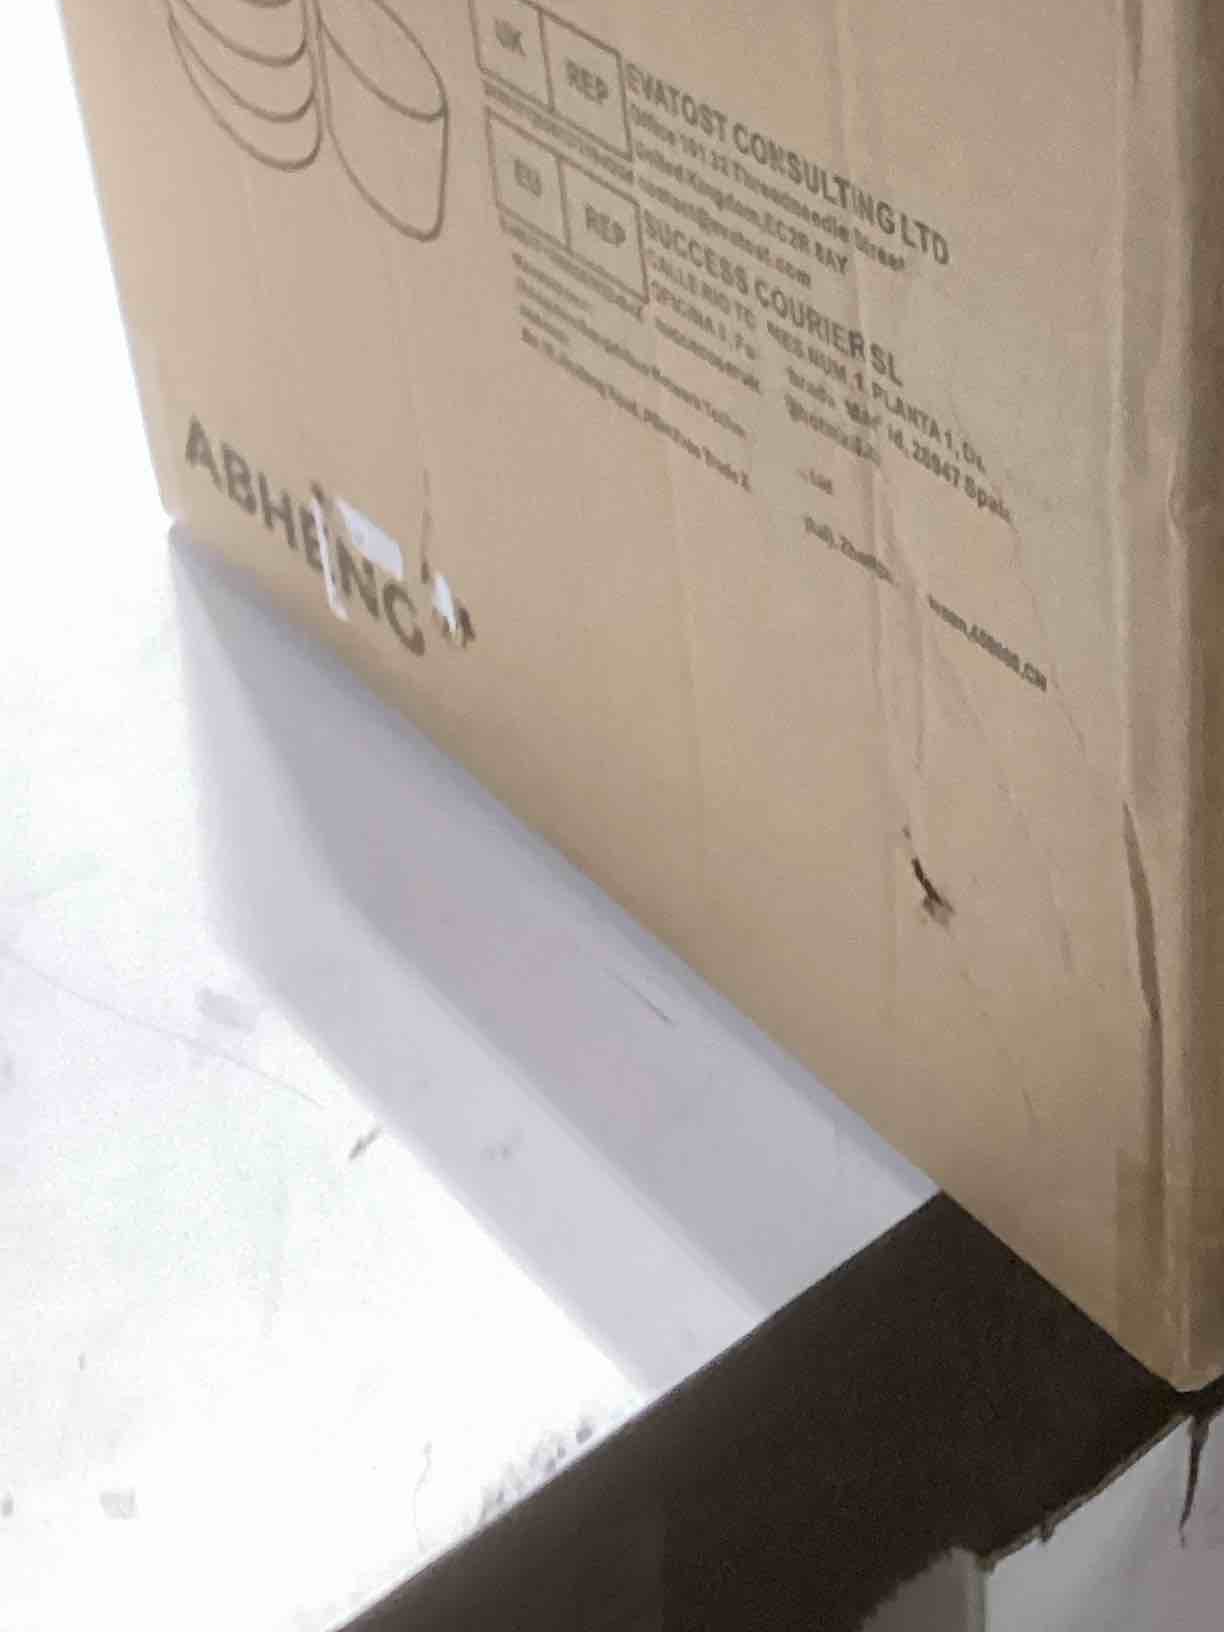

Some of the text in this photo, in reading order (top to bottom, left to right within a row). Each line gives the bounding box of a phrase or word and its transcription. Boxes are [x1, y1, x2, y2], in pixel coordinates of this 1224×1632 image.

[563, 56, 609, 105] REP
[625, 62, 729, 143] EVATOST
[732, 122, 896, 236] CONSULTING
[900, 211, 950, 265] LTD
[643, 207, 750, 295] SUCCESS
[753, 277, 866, 363] COURIER
[869, 341, 903, 388] SL
